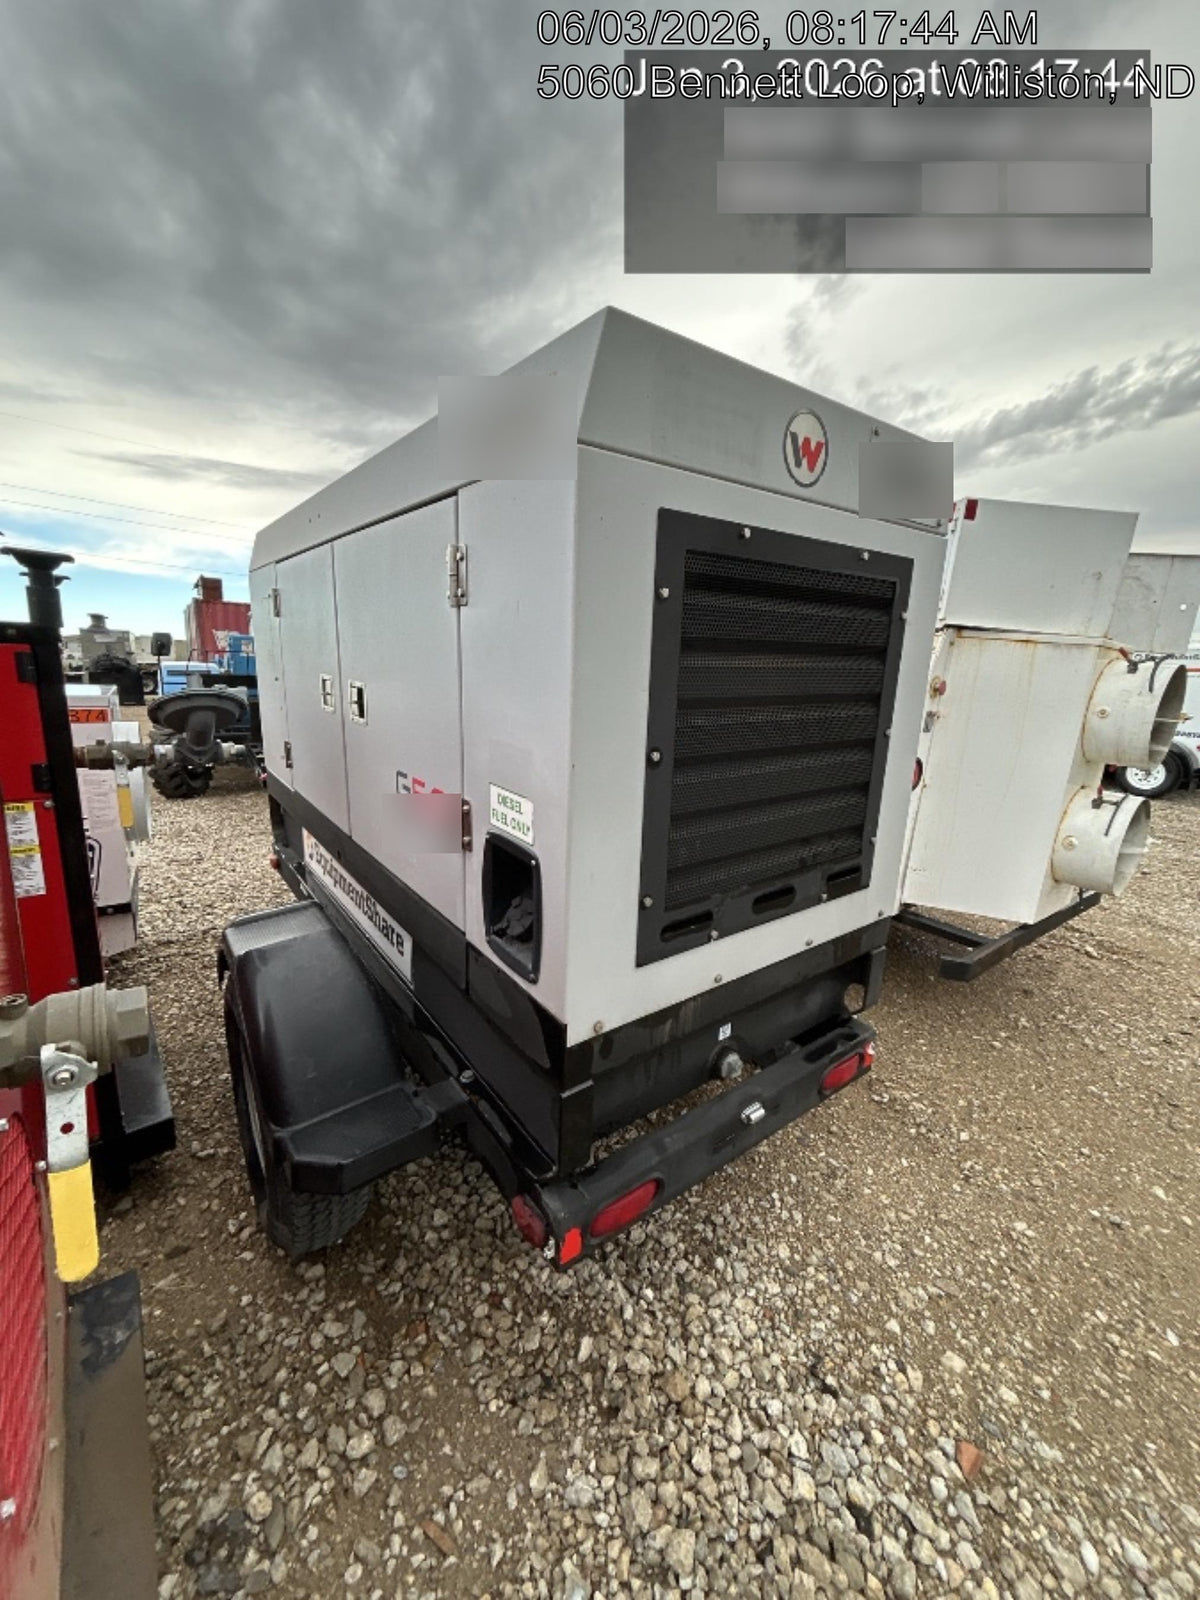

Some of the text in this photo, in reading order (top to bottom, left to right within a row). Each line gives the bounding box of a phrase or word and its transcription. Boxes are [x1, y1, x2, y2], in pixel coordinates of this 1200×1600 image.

[497, 793, 524, 815] DIESEL
[491, 808, 510, 827] FUEL
[313, 841, 405, 957] EquipmentShare
